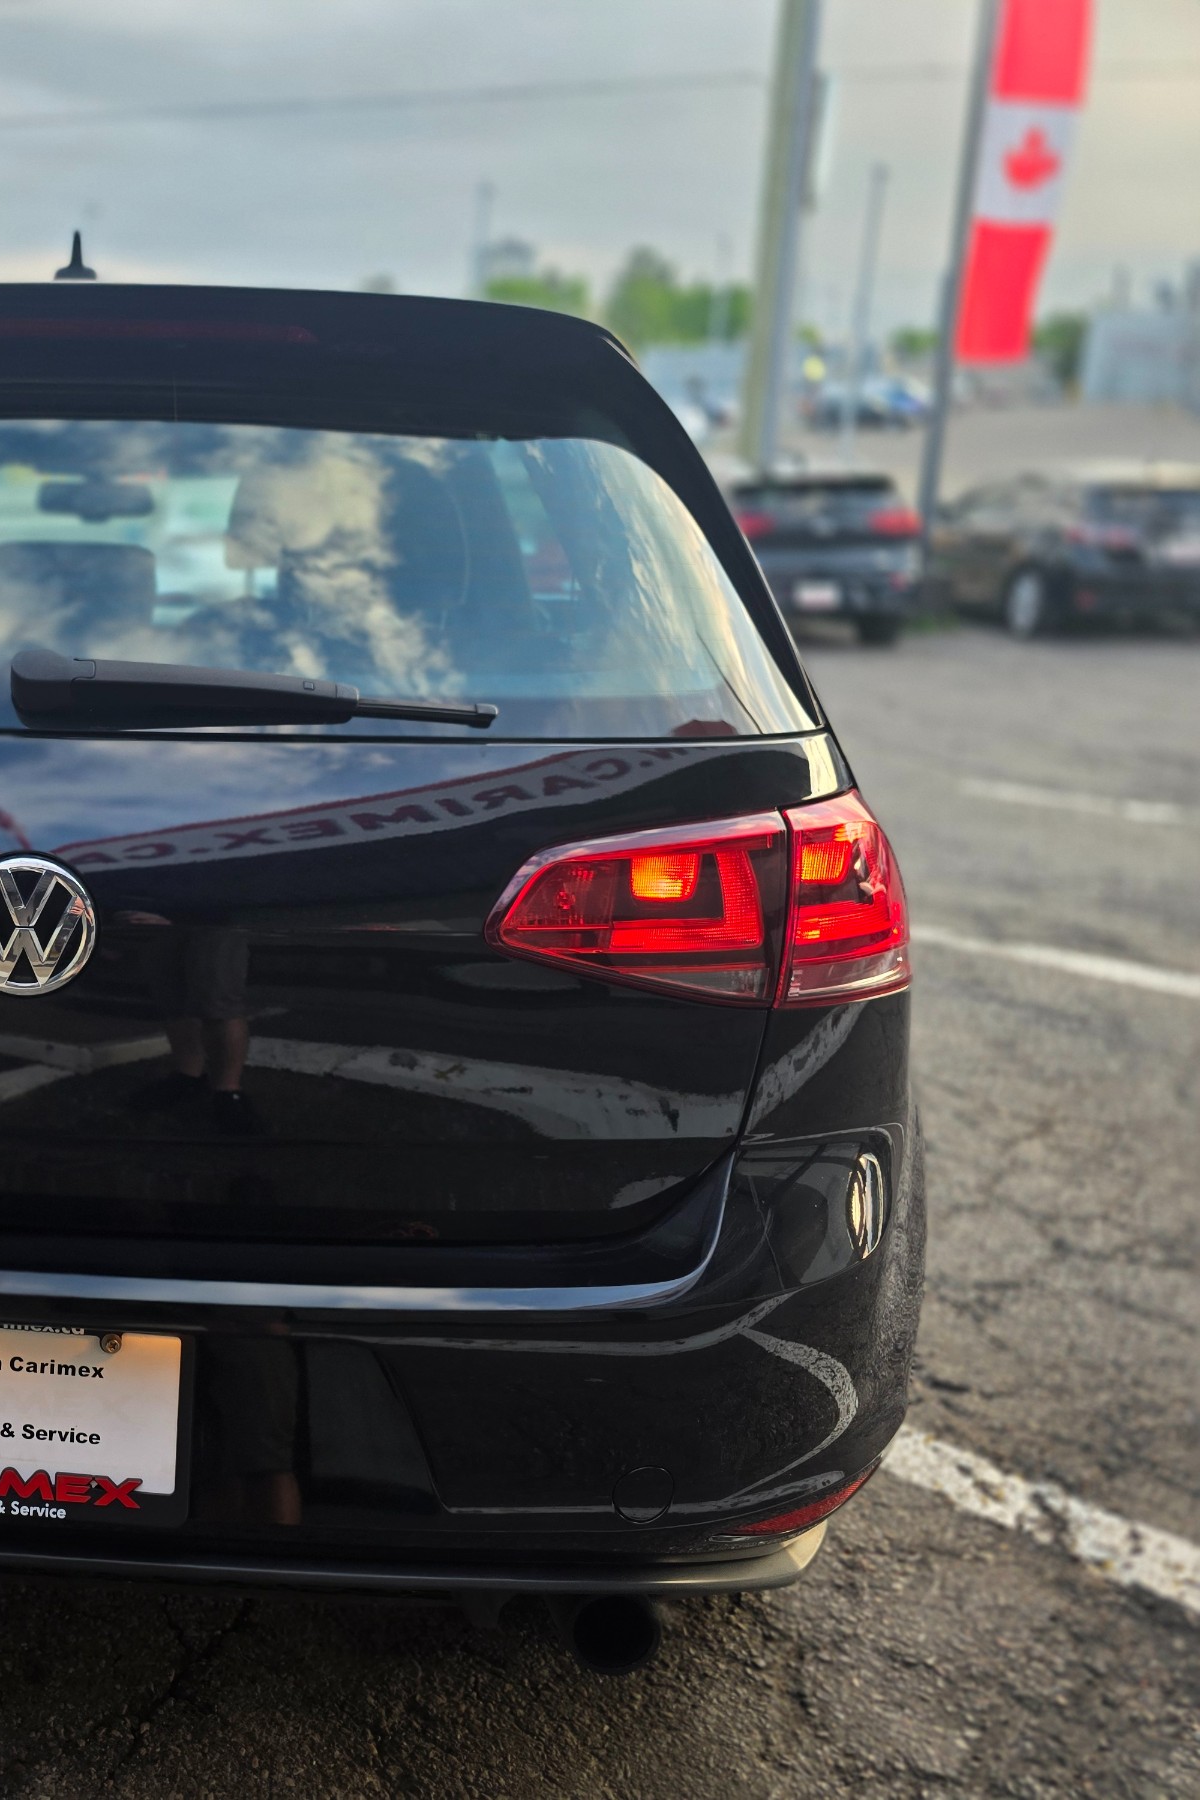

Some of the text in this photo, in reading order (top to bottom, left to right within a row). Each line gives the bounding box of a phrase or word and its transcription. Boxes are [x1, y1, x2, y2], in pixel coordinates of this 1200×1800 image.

[9, 1356, 105, 1379] Carimex
[0, 1422, 15, 1438] &
[21, 1424, 101, 1446] Service
[10, 1501, 67, 1519] Service
